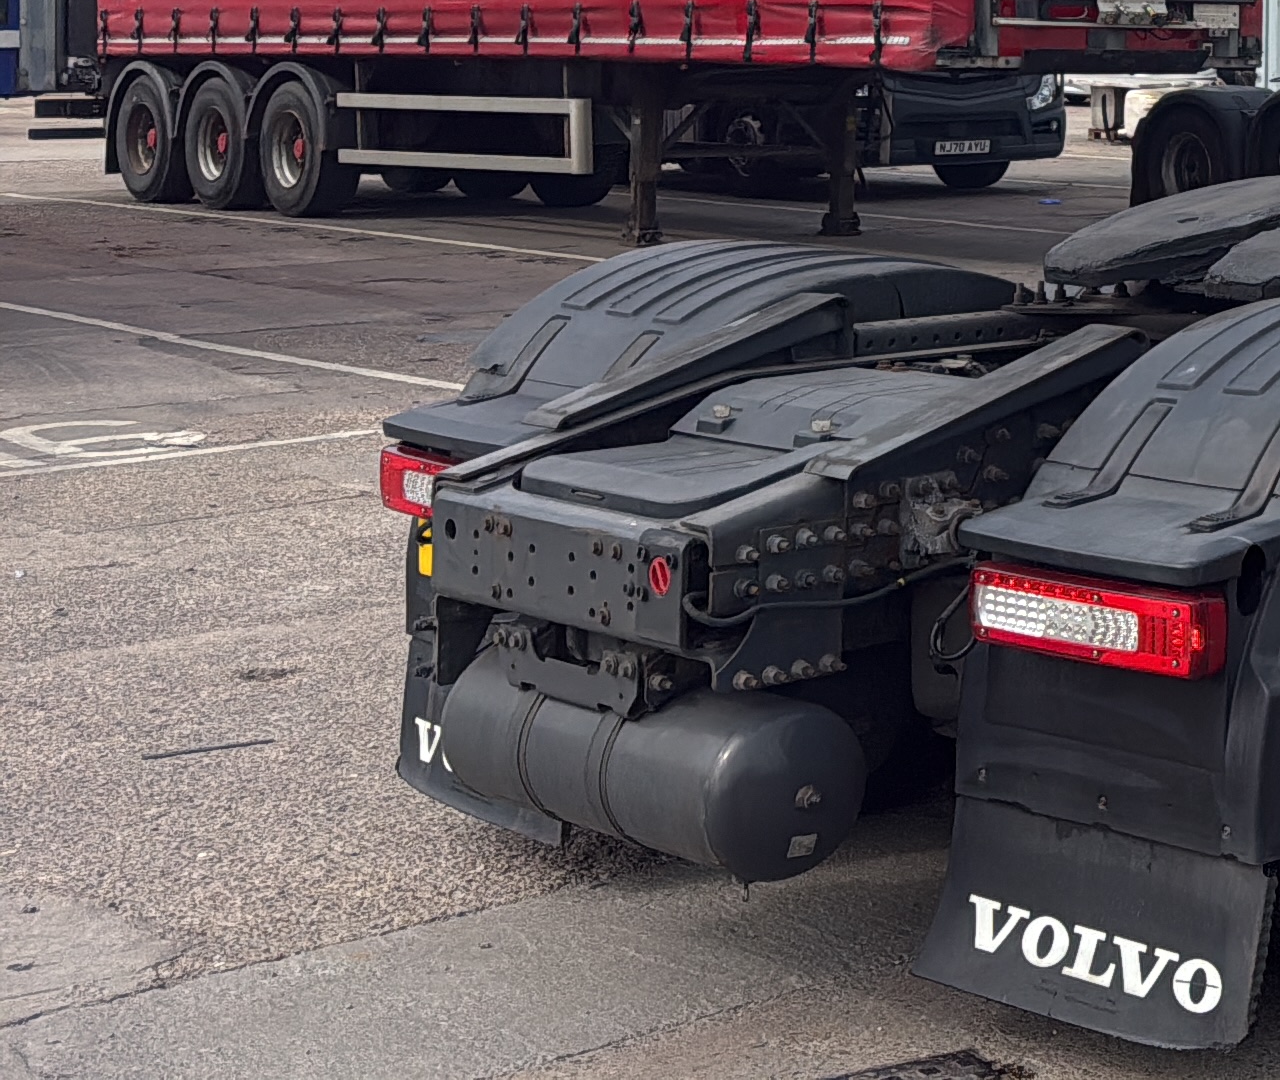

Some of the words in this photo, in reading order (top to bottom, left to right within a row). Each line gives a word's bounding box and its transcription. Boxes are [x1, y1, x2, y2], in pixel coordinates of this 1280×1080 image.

[940, 142, 965, 153] NJ70
[967, 141, 986, 152] AYU
[968, 893, 1223, 1014] VOLVO
